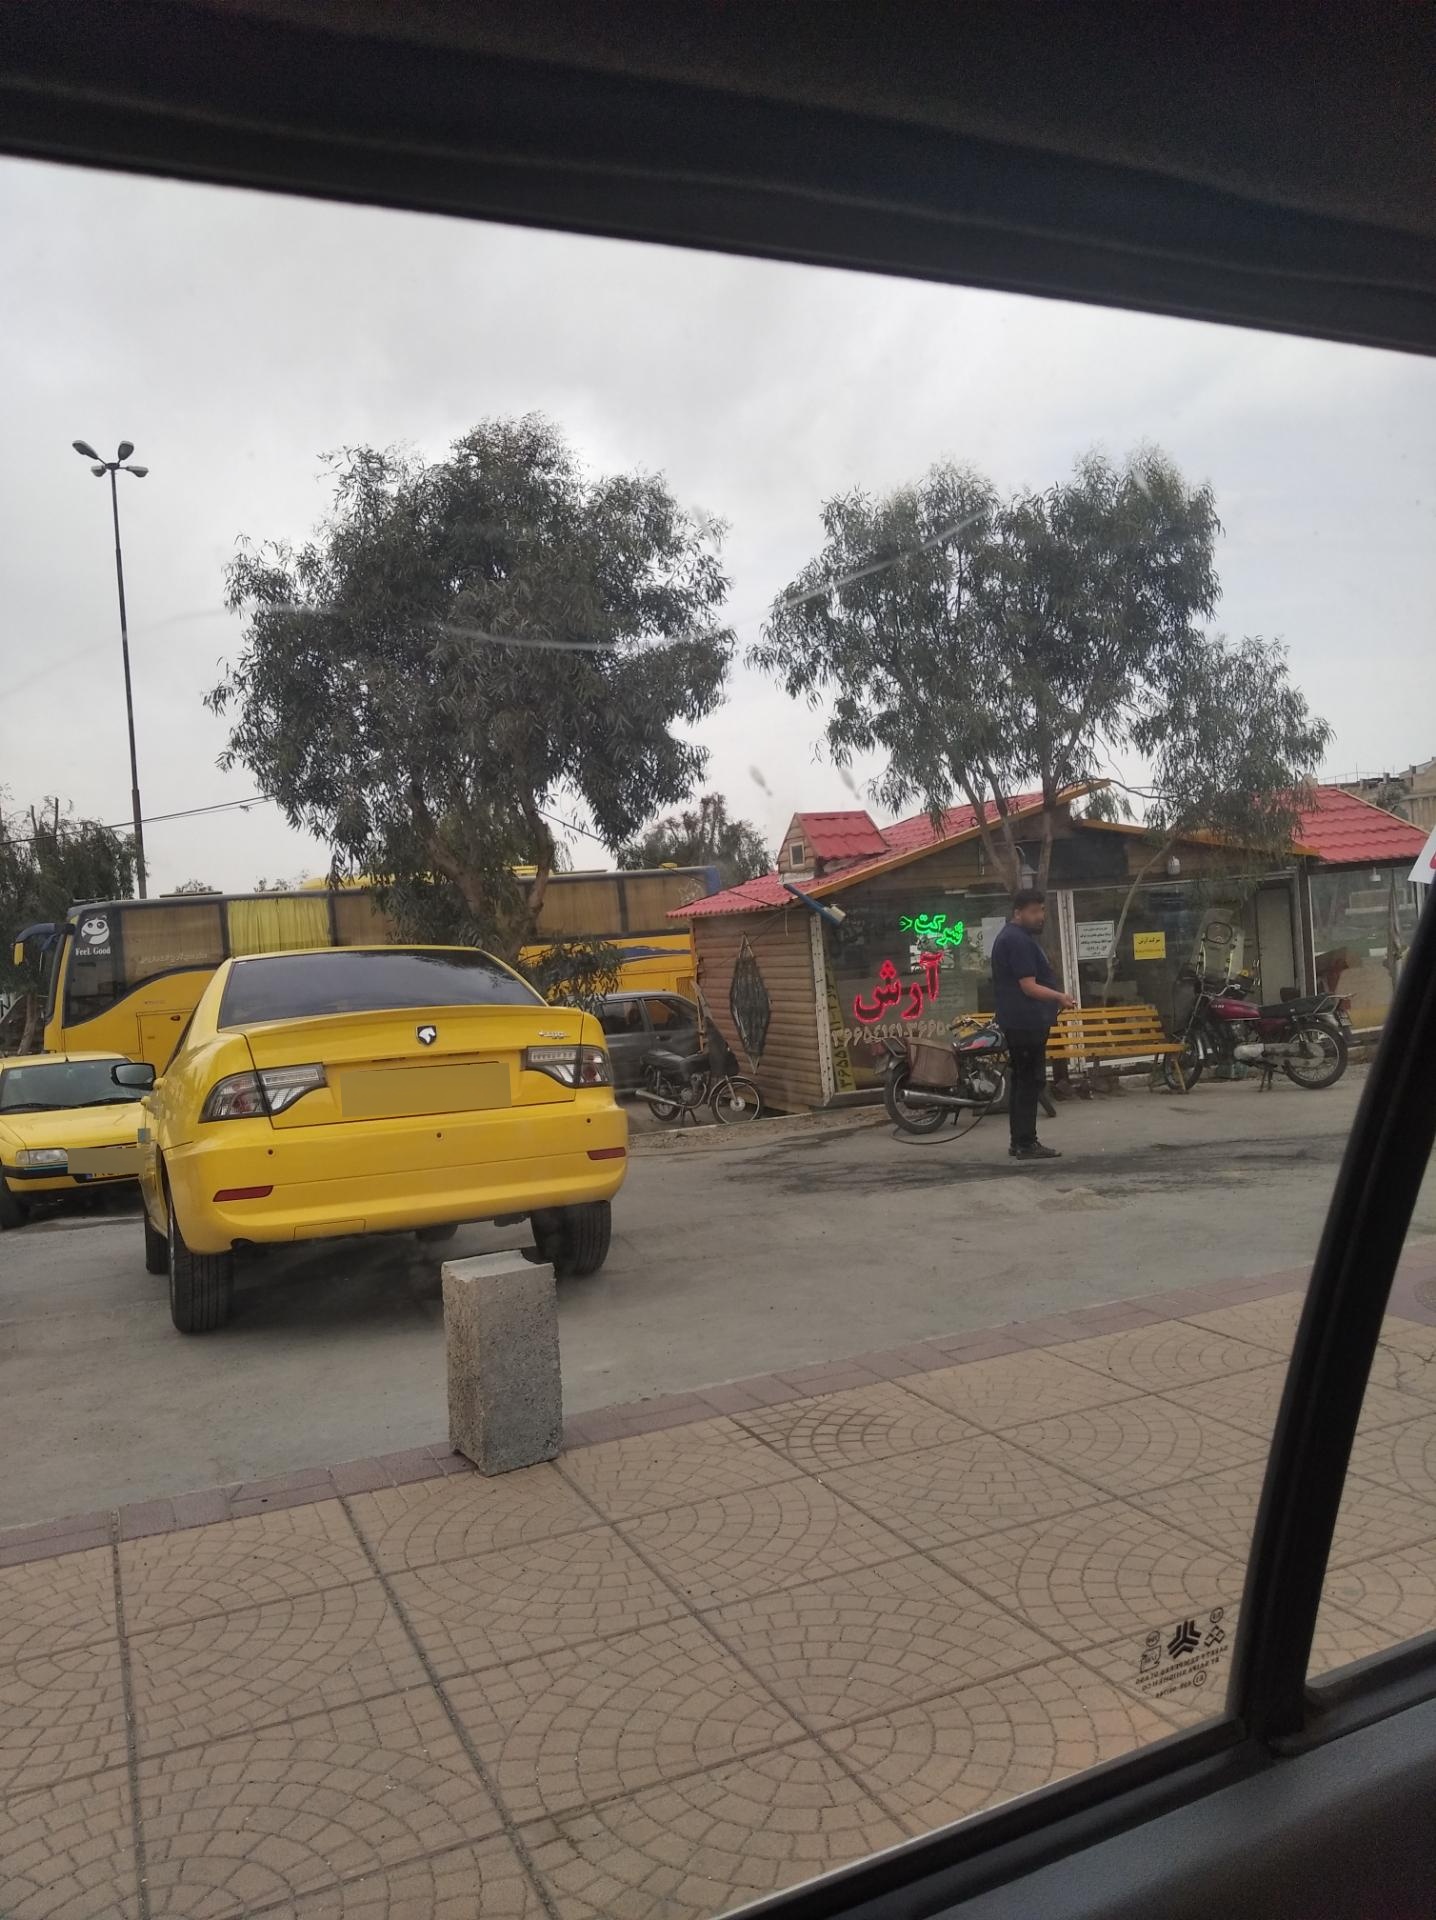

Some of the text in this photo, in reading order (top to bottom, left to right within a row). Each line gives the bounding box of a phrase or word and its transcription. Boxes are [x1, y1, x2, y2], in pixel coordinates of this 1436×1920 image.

[914, 913, 964, 946] شرکت
[93, 947, 111, 955] Good
[854, 952, 944, 1022] آرش
